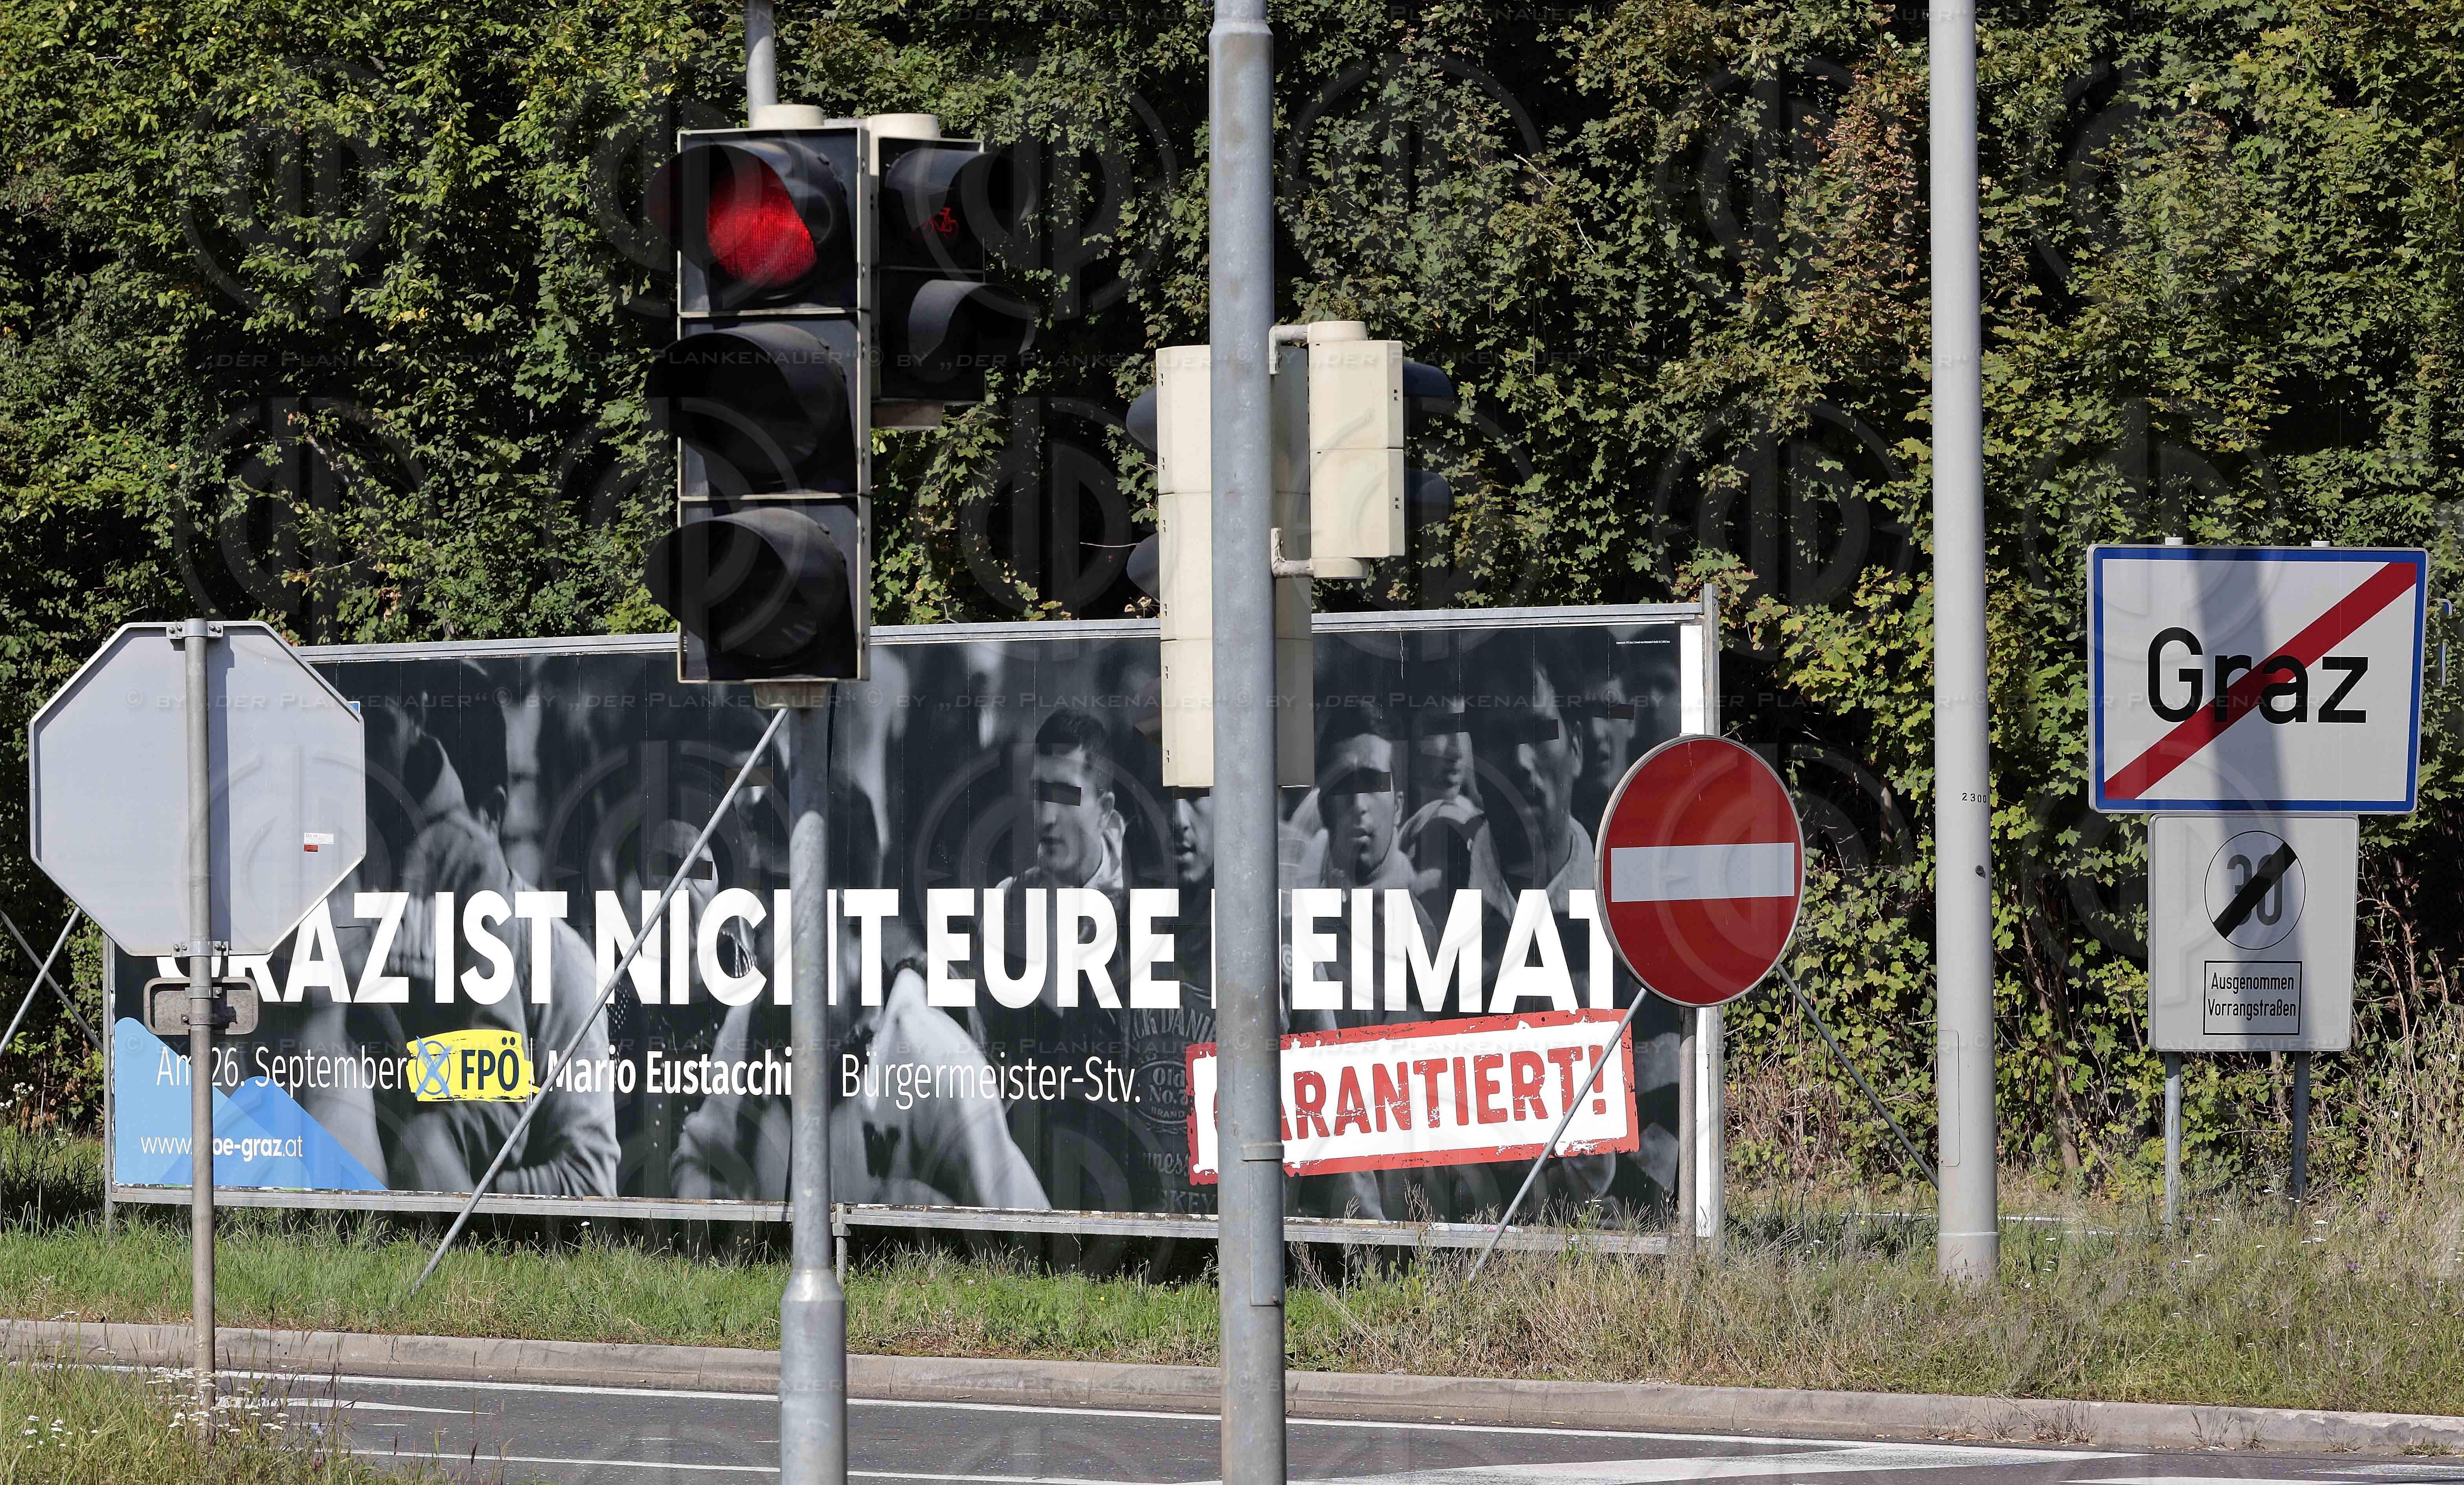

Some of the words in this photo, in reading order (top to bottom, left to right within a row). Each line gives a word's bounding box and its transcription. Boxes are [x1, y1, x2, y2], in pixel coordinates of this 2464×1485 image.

[2147, 627, 2368, 724] Graz
[1962, 792, 1987, 803] 2300
[156, 892, 409, 1003] AZ
[435, 890, 567, 1005] IST
[927, 888, 1180, 1009] EURE
[1212, 888, 1614, 1014] EIMAT
[2211, 972, 2294, 994] Ausgenommen
[2208, 998, 2296, 1021] Vorrangstraßen
[256, 1046, 407, 1098] September
[461, 1037, 520, 1092] FPÖ
[549, 1045, 636, 1093] Mario
[646, 1046, 792, 1096] Eustacchi
[842, 1051, 1141, 1111] Bürgermeister-Stv.
[1214, 1045, 1607, 1140] RANTIERT!
[139, 1135, 303, 1163] www.oe-graz.at
